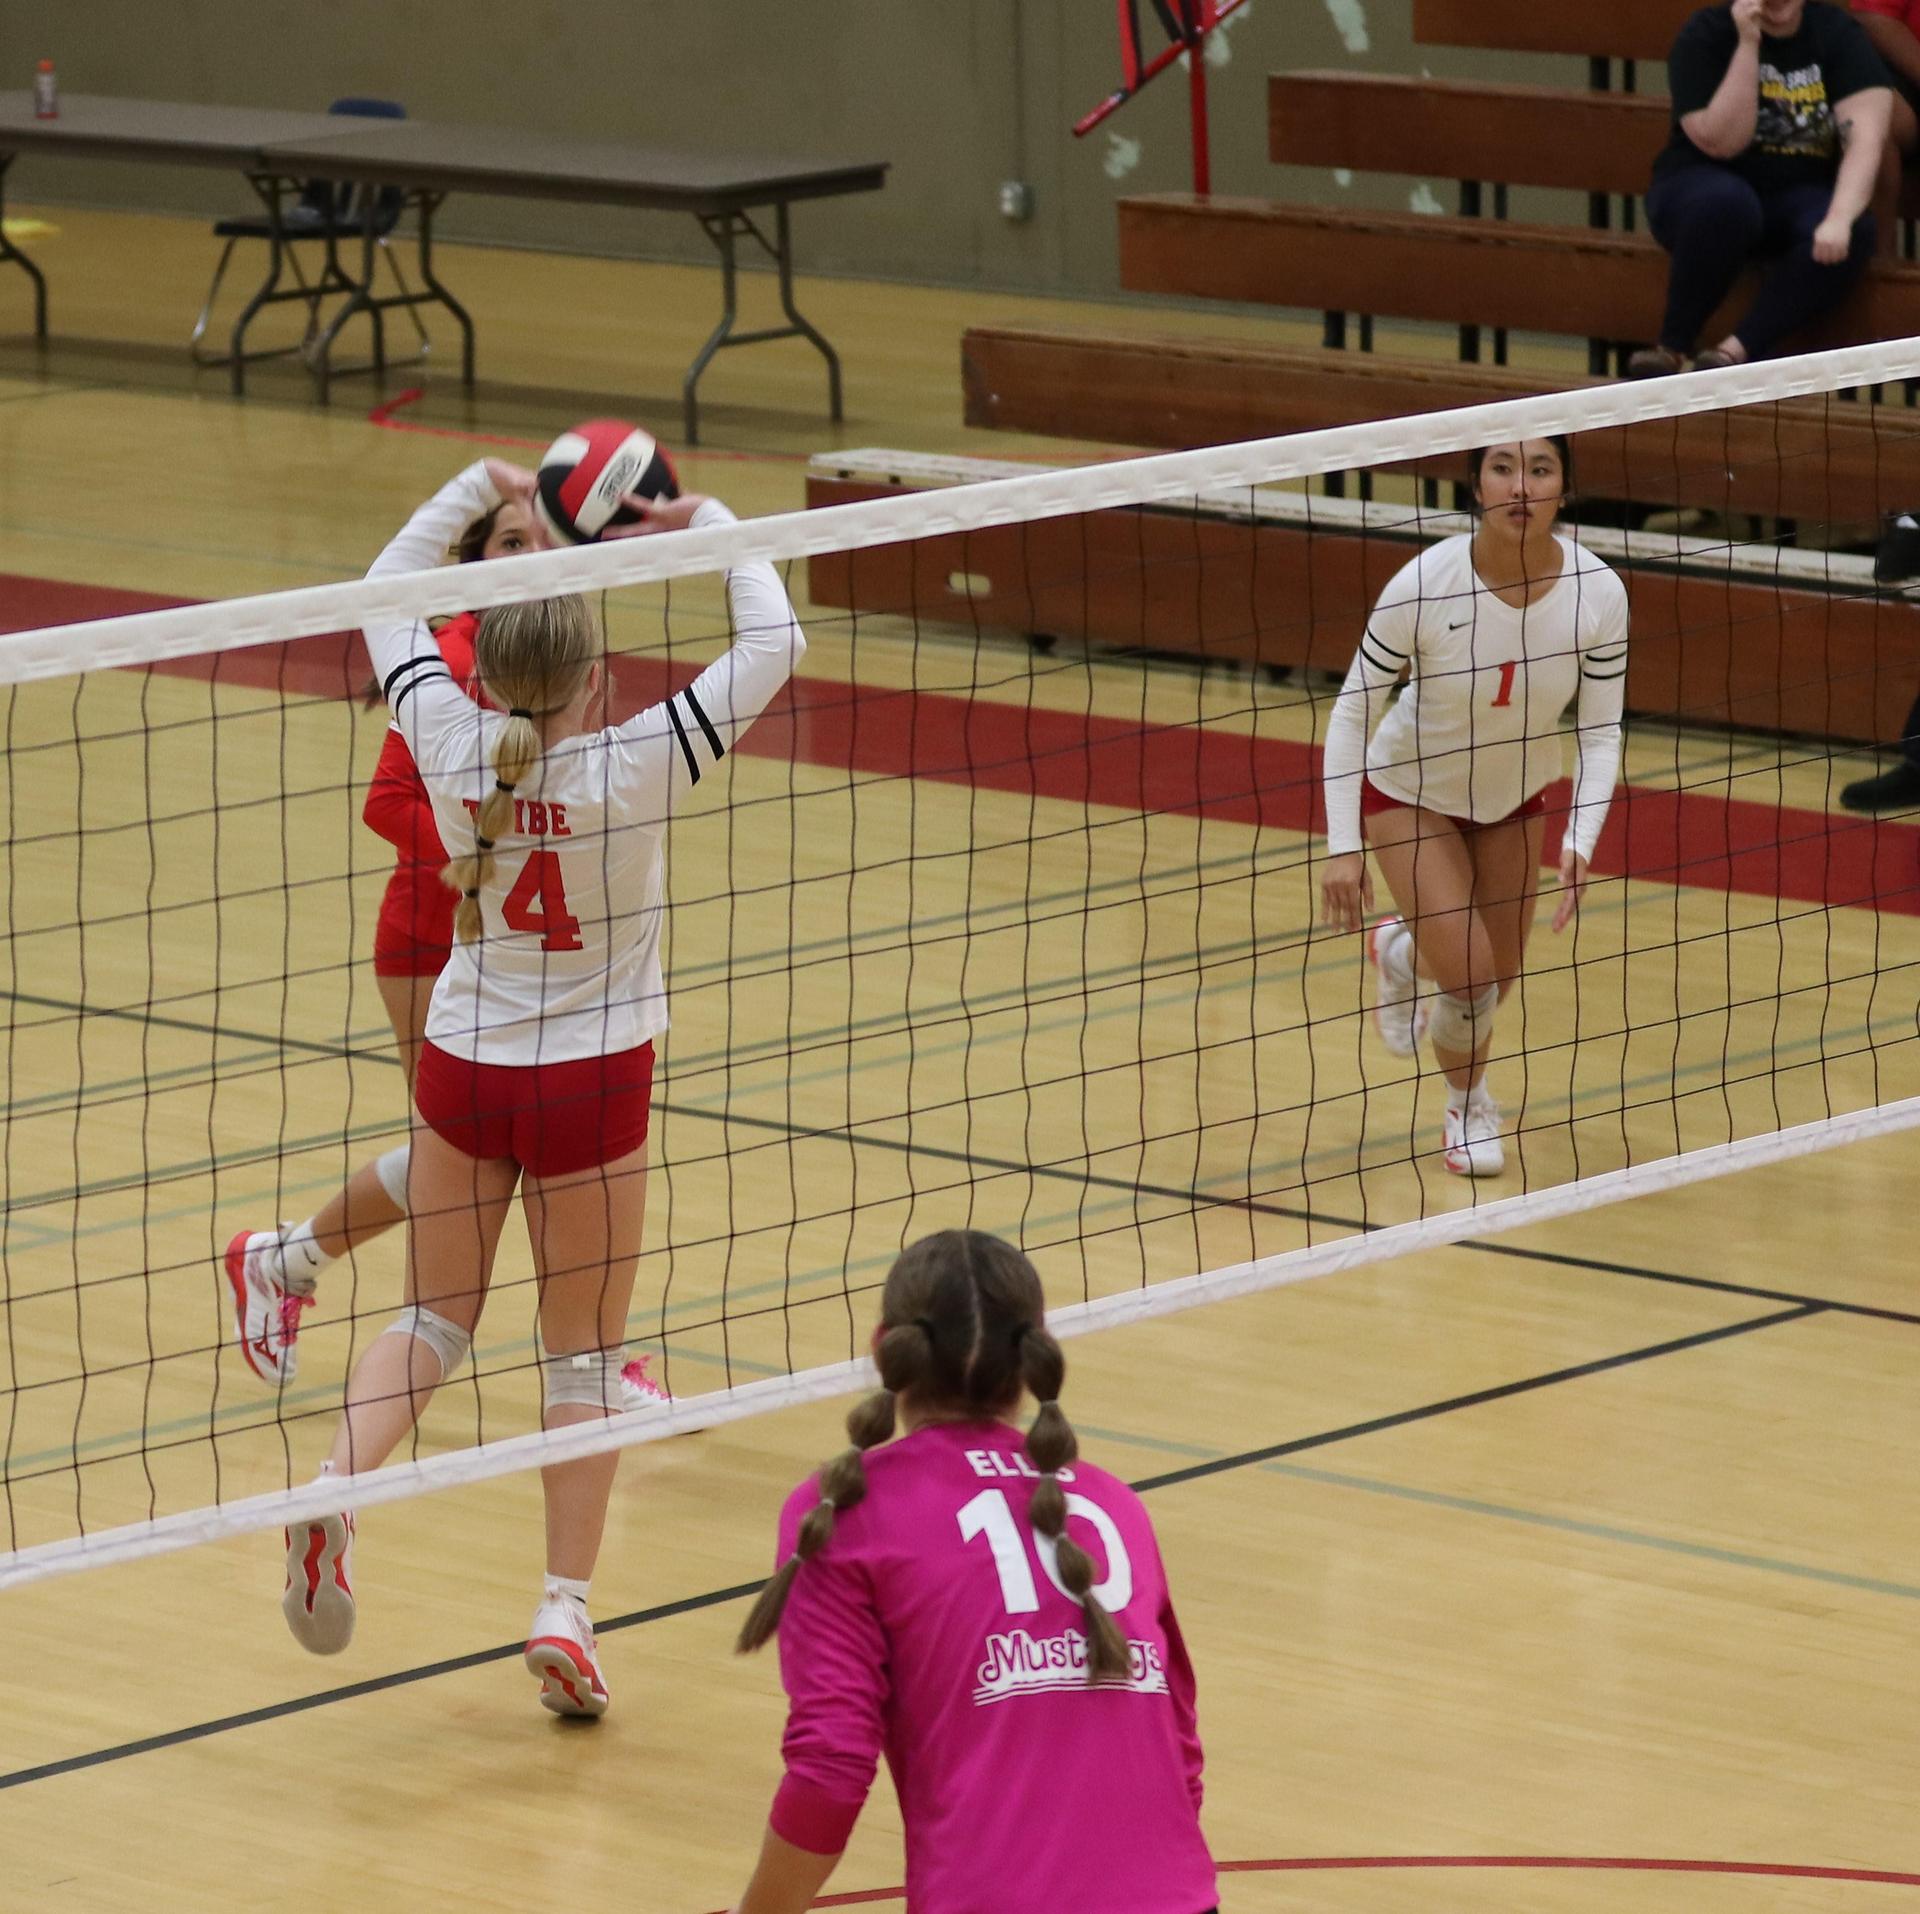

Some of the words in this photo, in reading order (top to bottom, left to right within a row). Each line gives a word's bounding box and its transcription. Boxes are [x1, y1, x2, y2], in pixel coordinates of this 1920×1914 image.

[1491, 660, 1516, 707] 1
[462, 798, 572, 836] TIBE
[501, 850, 584, 951] 4
[963, 1449, 1077, 1483] ELLS
[956, 1488, 1133, 1614] 10
[976, 1629, 1164, 1682] Mustgs
